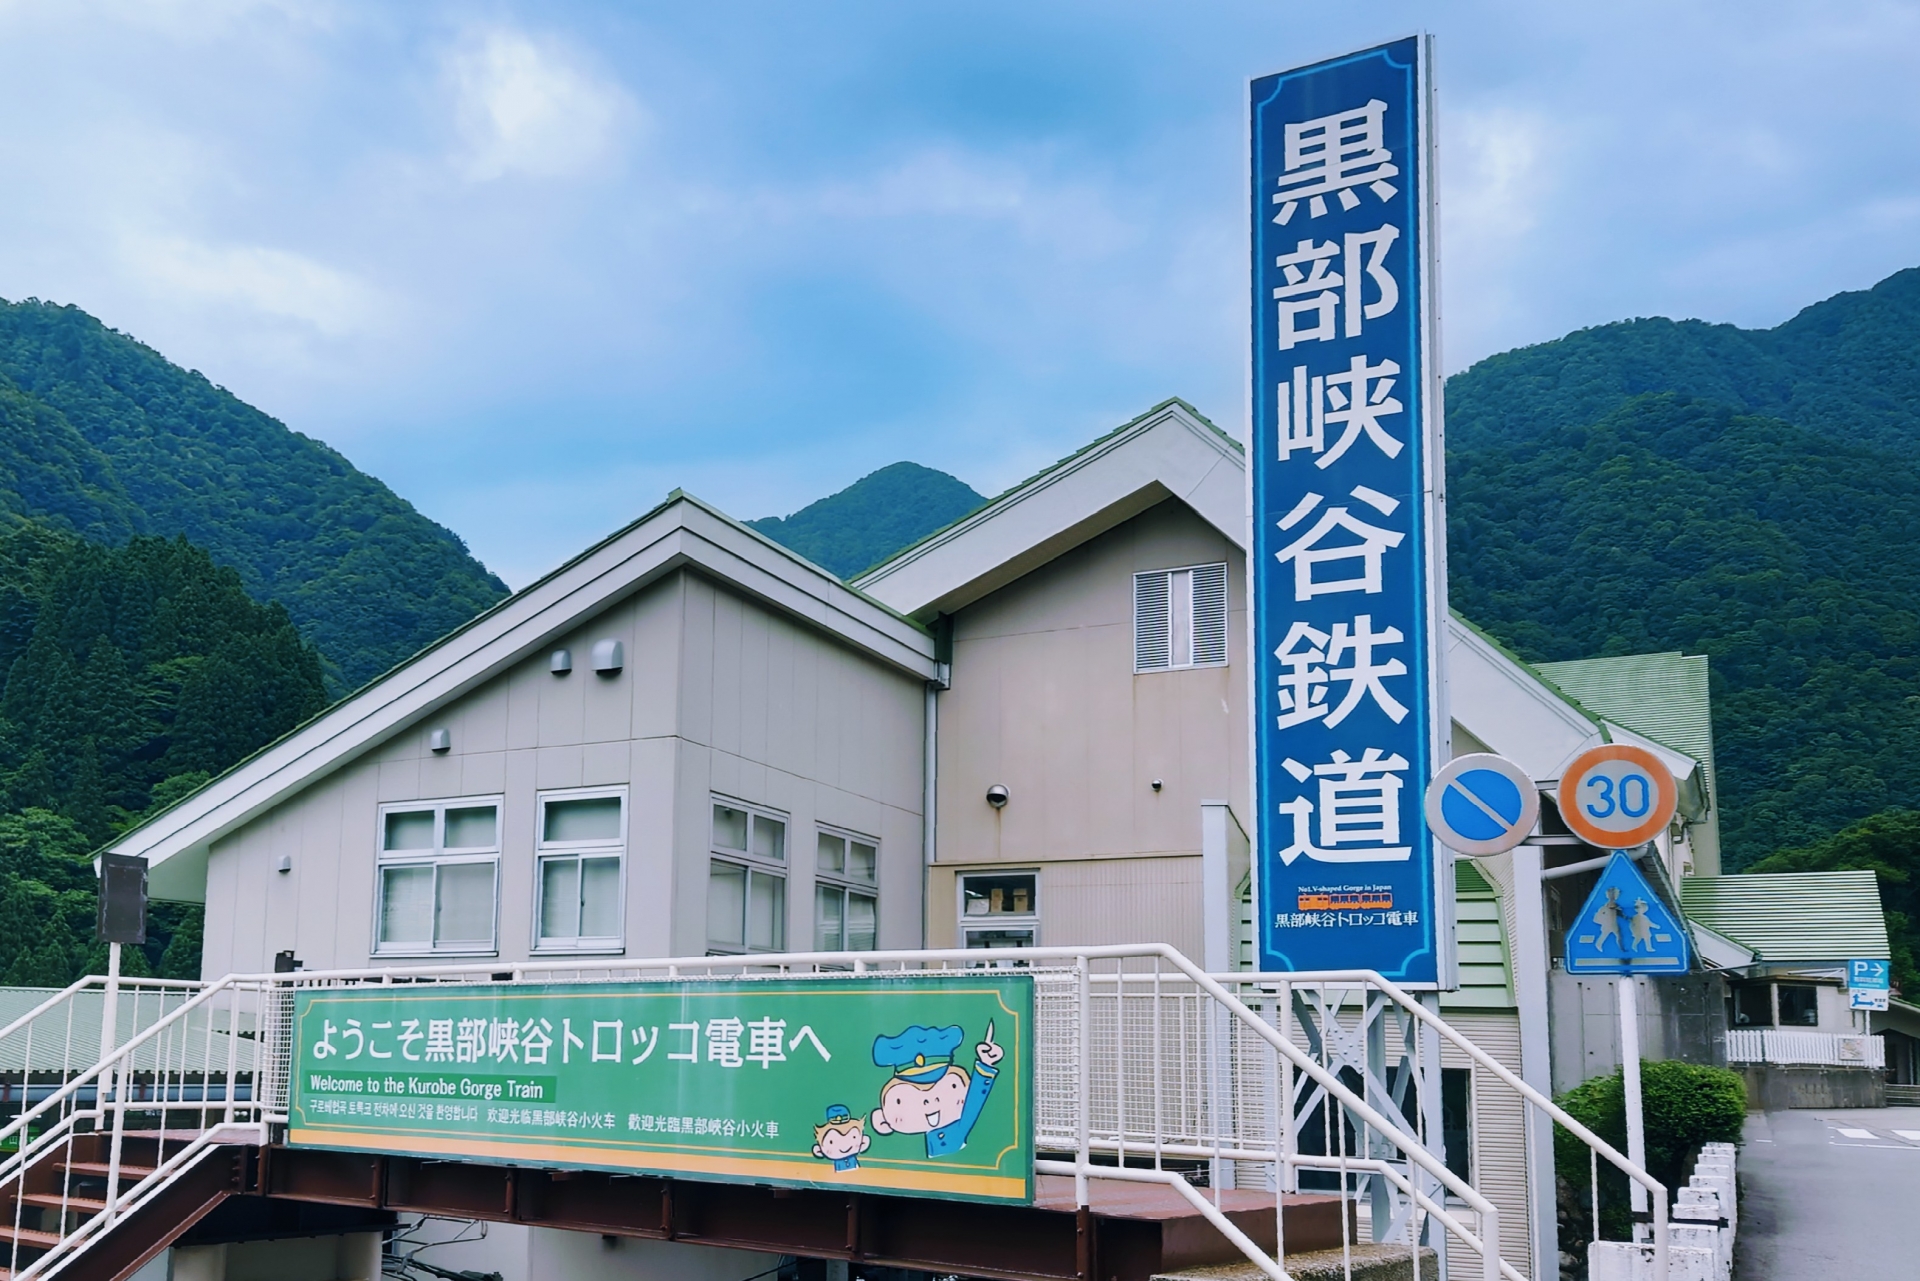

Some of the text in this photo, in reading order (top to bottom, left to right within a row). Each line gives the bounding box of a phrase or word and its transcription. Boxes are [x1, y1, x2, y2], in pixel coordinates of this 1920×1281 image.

[1272, 98, 1412, 867] 黒部峡谷鉄道
[1587, 774, 1649, 818] 30
[1343, 884, 1363, 892] Gorge
[1373, 883, 1392, 892] Japan
[1275, 910, 1419, 928] 黒部峡谷トロッコ電車
[1854, 961, 1868, 976] P
[313, 1016, 832, 1069] ようこそ黒部峡谷トロッコ電車へ
[310, 1075, 543, 1100] Welcome to the Kurobe Gorge Train
[399, 1103, 416, 1119] 오신
[418, 1103, 434, 1120] 것을
[436, 1104, 478, 1122] 환영합니다
